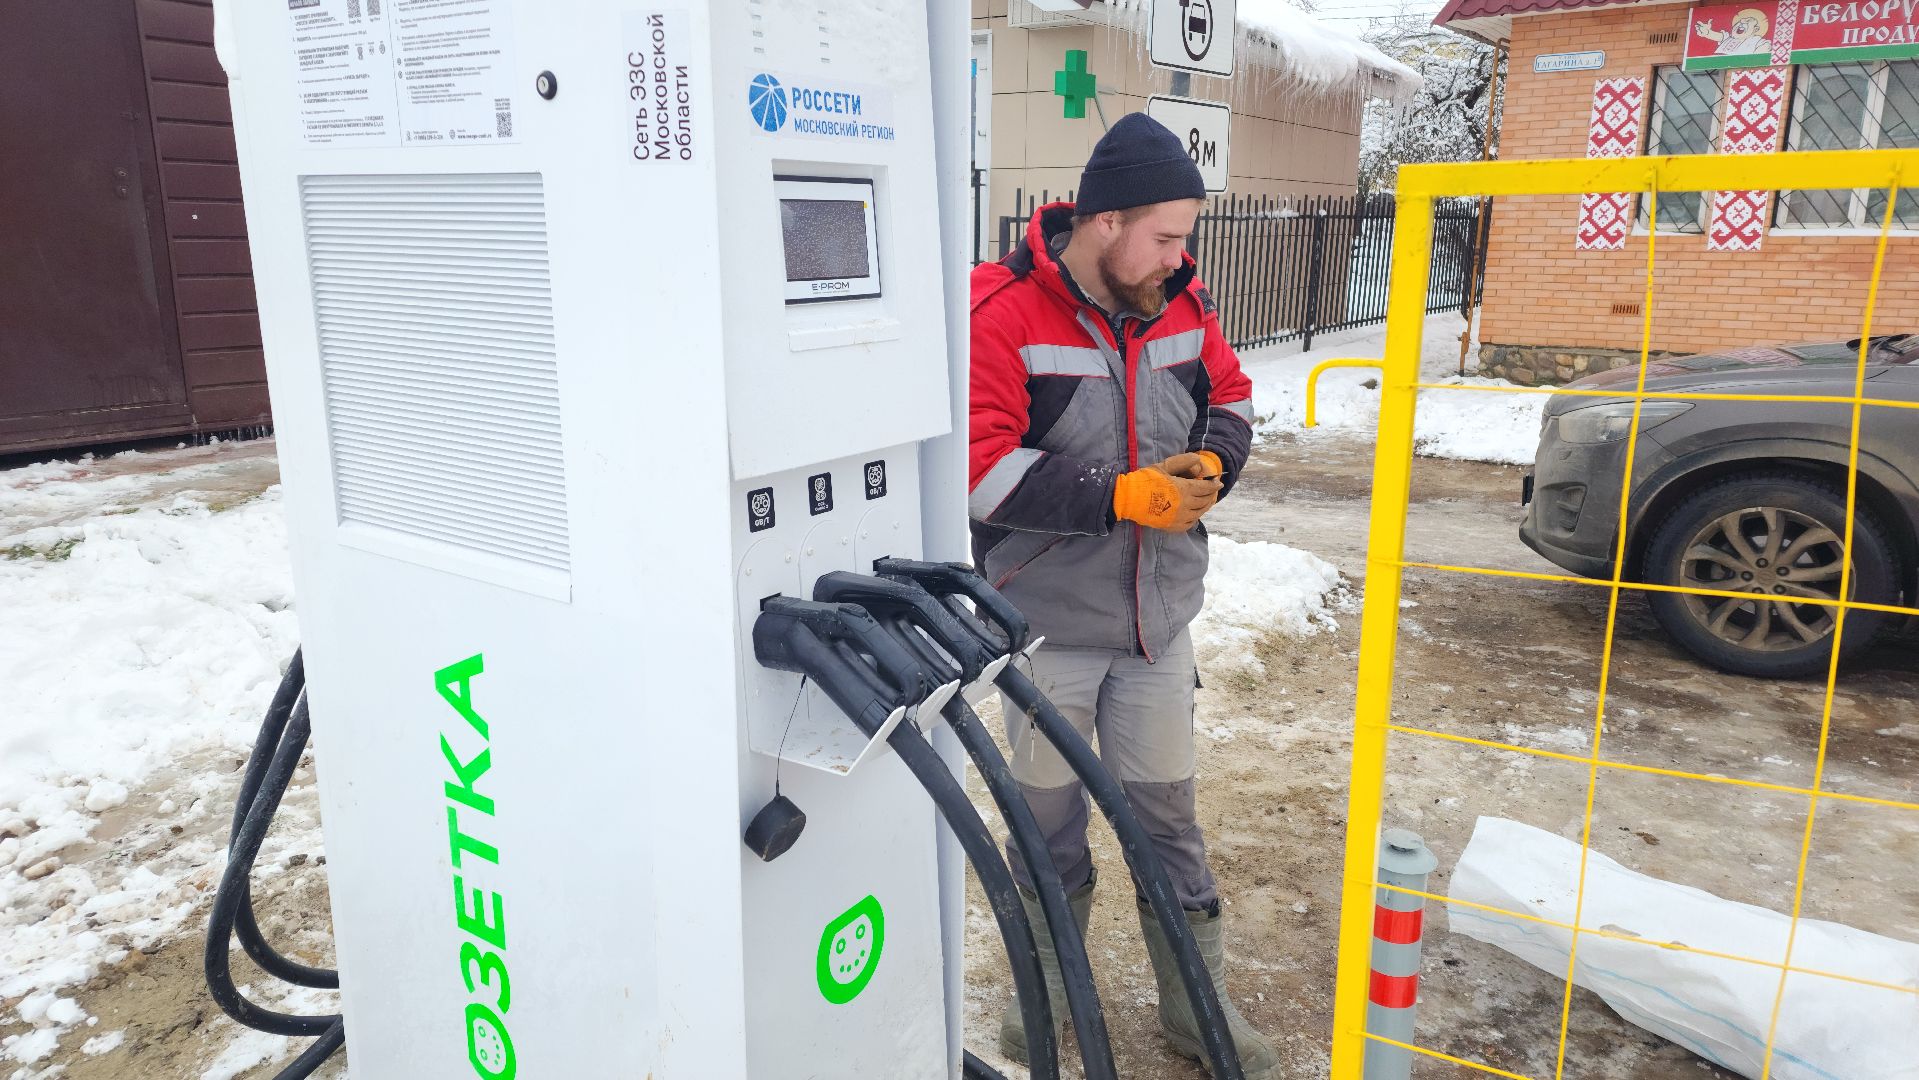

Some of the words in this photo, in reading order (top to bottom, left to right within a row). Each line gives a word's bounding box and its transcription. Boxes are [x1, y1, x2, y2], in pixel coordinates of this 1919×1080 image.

[628, 52, 647, 101] ЭЗС
[1536, 59, 1584, 69] ГАГАРИНА
[647, 14, 671, 160] Московской
[792, 87, 861, 116] РОССЕТИ
[674, 66, 692, 161] области
[794, 118, 859, 138] МОСКОВСКИЙ
[861, 124, 895, 140] РЕГИОН
[633, 107, 650, 161] Сеть
[754, 516, 770, 527] GB/T
